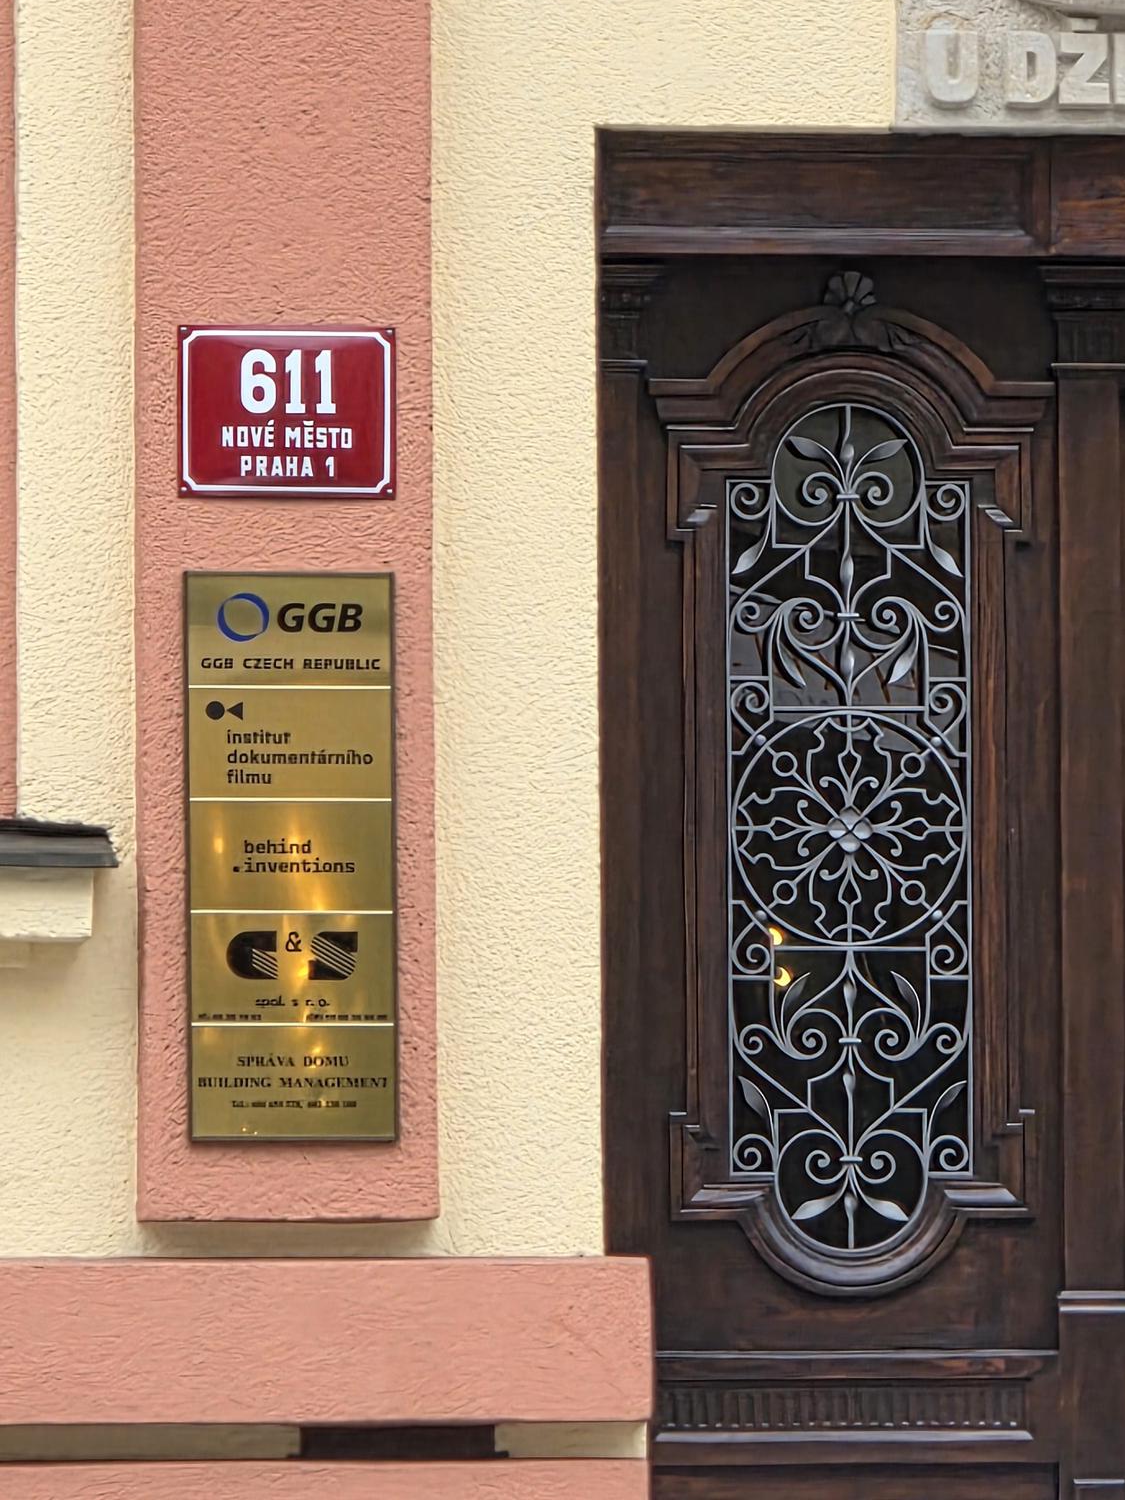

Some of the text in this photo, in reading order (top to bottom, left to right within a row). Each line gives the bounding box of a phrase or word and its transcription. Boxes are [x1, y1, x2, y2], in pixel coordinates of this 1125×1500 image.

[925, 29, 979, 103] U
[240, 349, 337, 415] 611
[221, 419, 353, 449] NOVÉ MĚSTO
[240, 456, 335, 477] PRAHA 1
[277, 602, 363, 634] GGB
[201, 657, 381, 671] GGB CZECH REPUBLIC
[226, 729, 291, 745] institut
[226, 749, 374, 765] dokumentárního
[226, 769, 272, 785] filmu
[243, 838, 312, 855] behind
[236, 1052, 350, 1068] SPRÁVA DOMU
[198, 1076, 388, 1089] BUILDING MANAGEMENT
